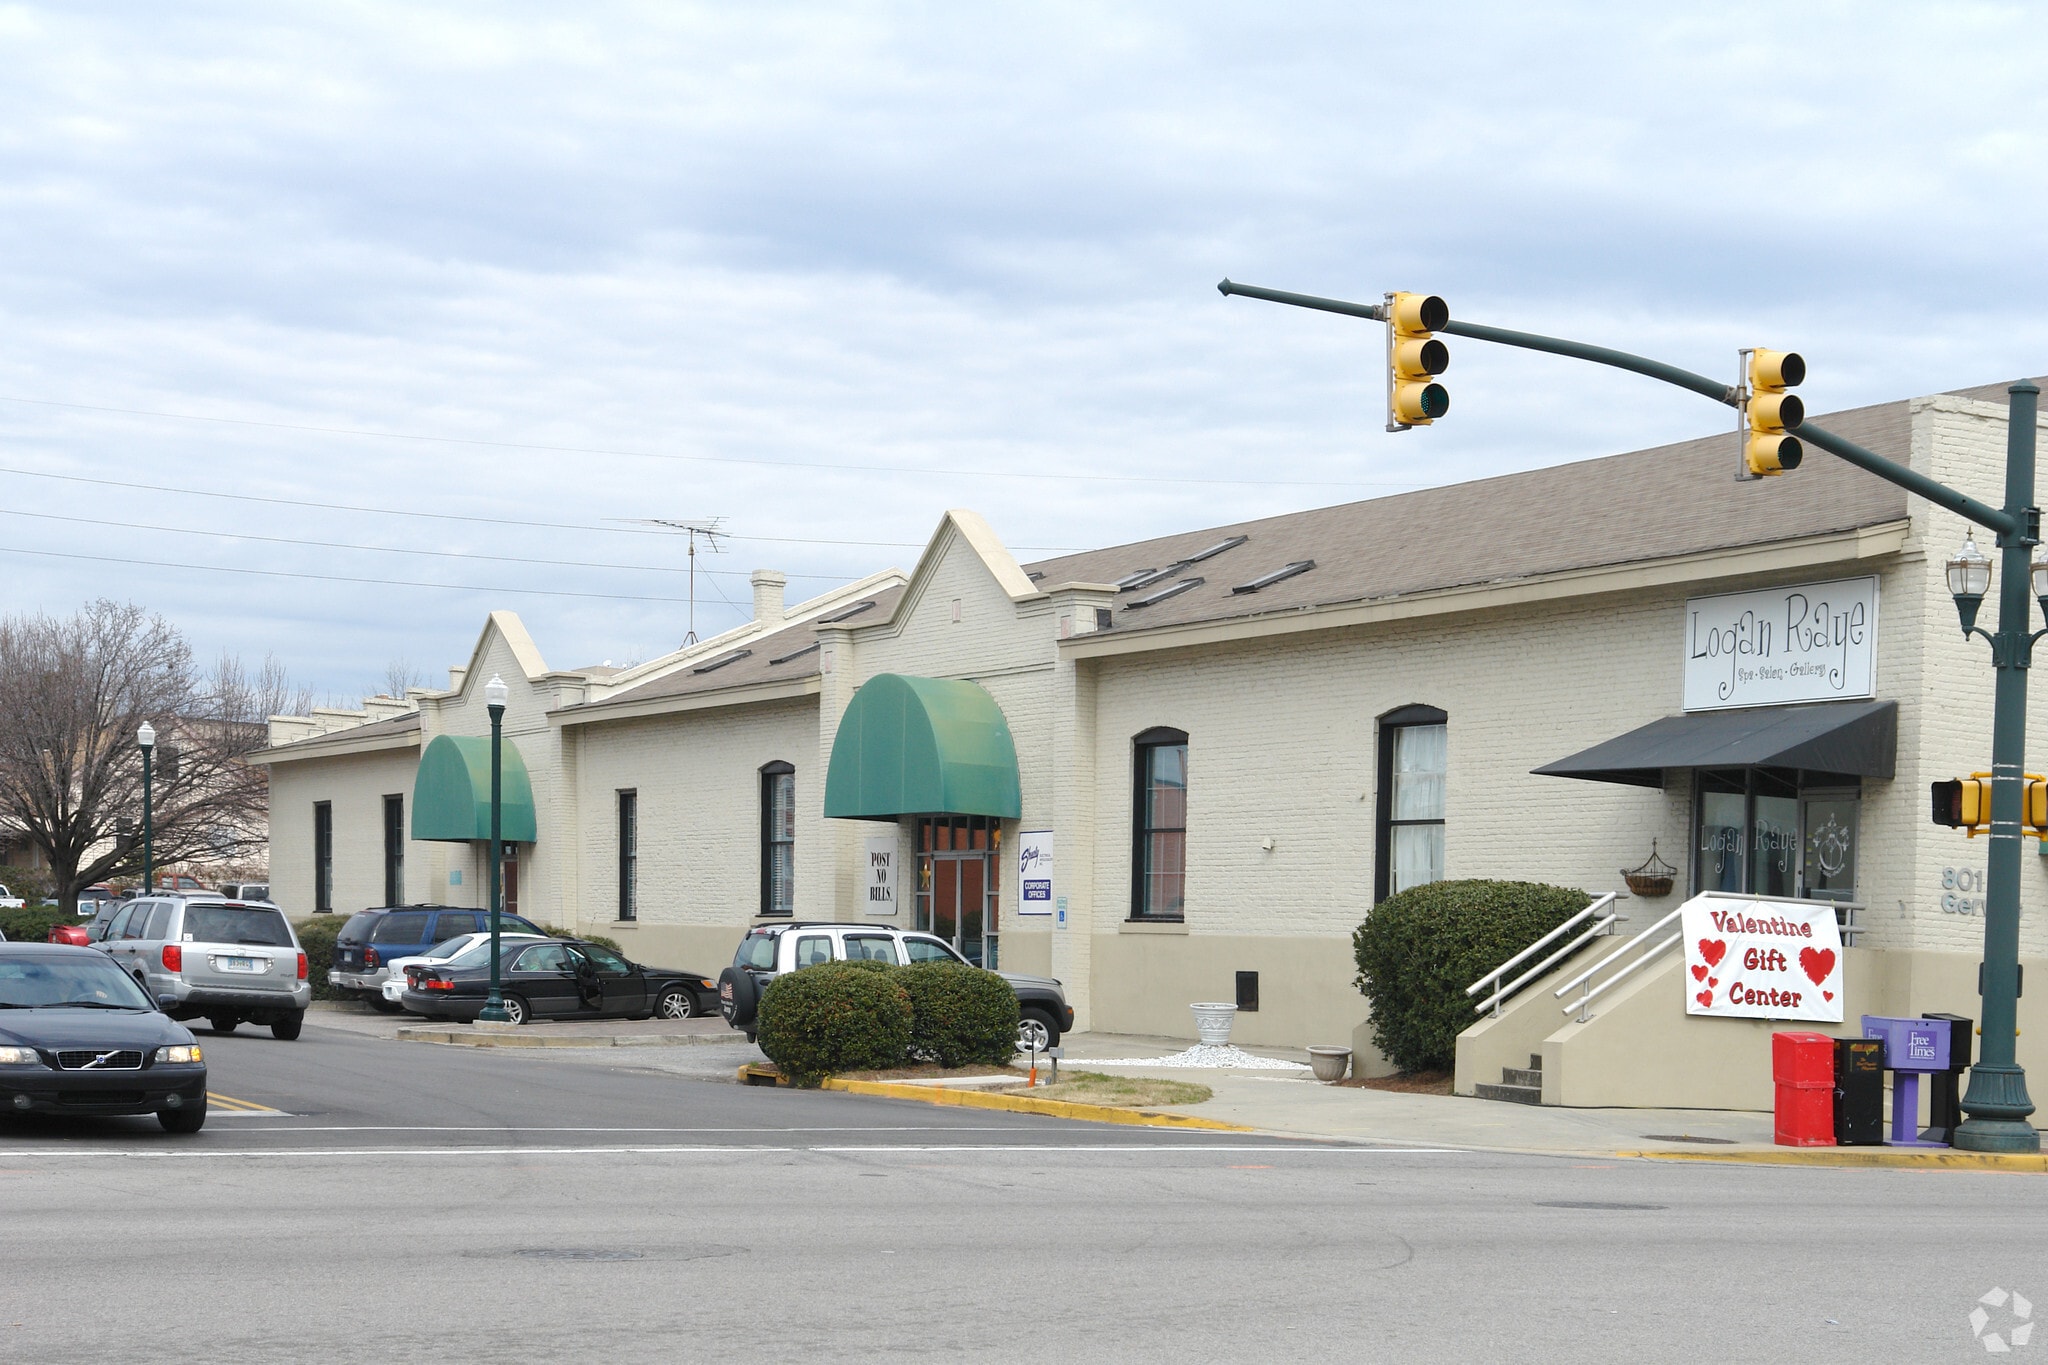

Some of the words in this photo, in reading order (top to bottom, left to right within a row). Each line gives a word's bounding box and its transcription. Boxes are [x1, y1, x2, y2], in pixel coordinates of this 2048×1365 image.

[1691, 610, 1771, 701] Logan
[1784, 593, 1865, 690] Raye
[1738, 667, 1753, 684] Spa
[1790, 661, 1826, 678] Gallery
[1701, 824, 1743, 874] Logan
[1754, 819, 1797, 873] Raye
[871, 852, 891, 867] POST
[876, 868, 887, 884] NO
[1024, 881, 1050, 890] CORPORATE
[1941, 867, 1982, 892] 801
[1028, 890, 1046, 899] OFFICES
[1710, 910, 1812, 938] Valentine
[1743, 947, 1787, 972] Gift
[1729, 981, 1802, 1008] Center
[1908, 1043, 1935, 1057] Times
[1910, 1031, 1930, 1046] Free
